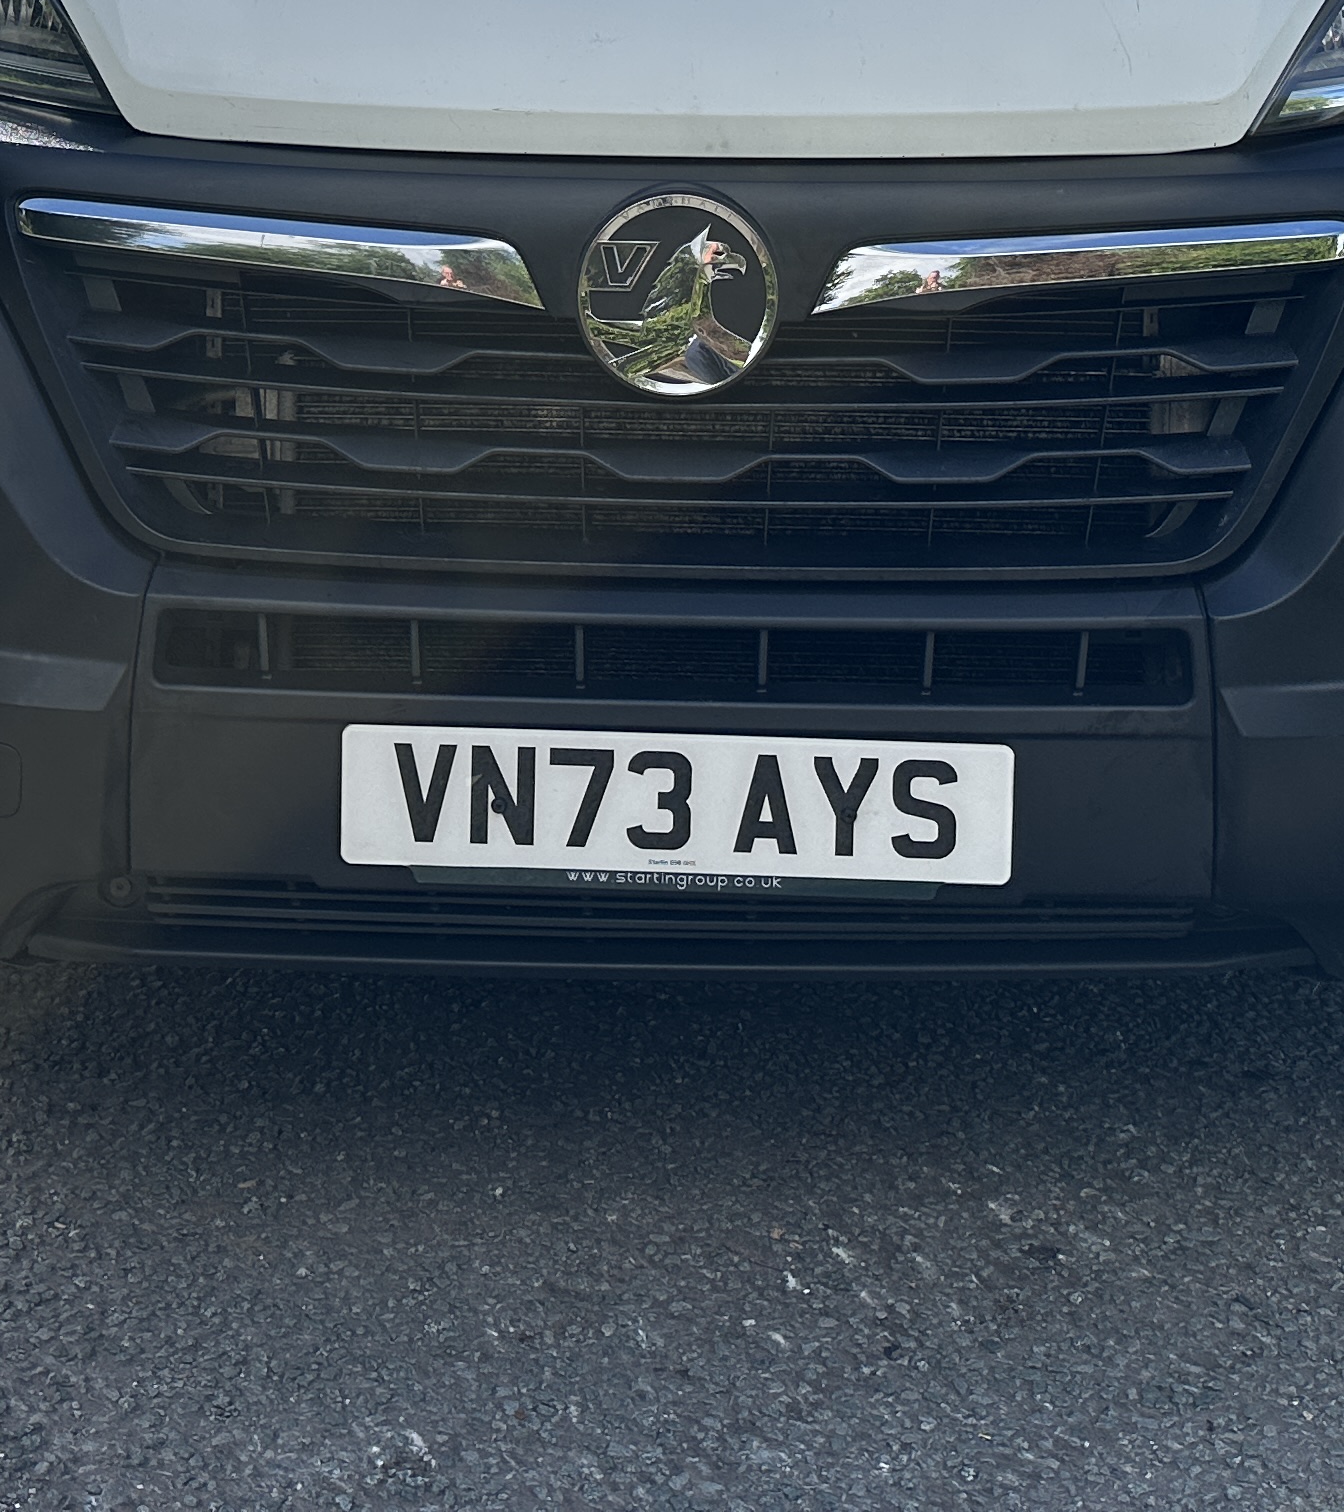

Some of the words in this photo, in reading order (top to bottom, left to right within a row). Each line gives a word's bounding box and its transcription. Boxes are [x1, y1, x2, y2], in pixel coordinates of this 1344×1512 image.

[393, 742, 693, 850] VN73
[732, 753, 958, 860] AYS
[566, 870, 782, 891] www.startingroup.co.uk
